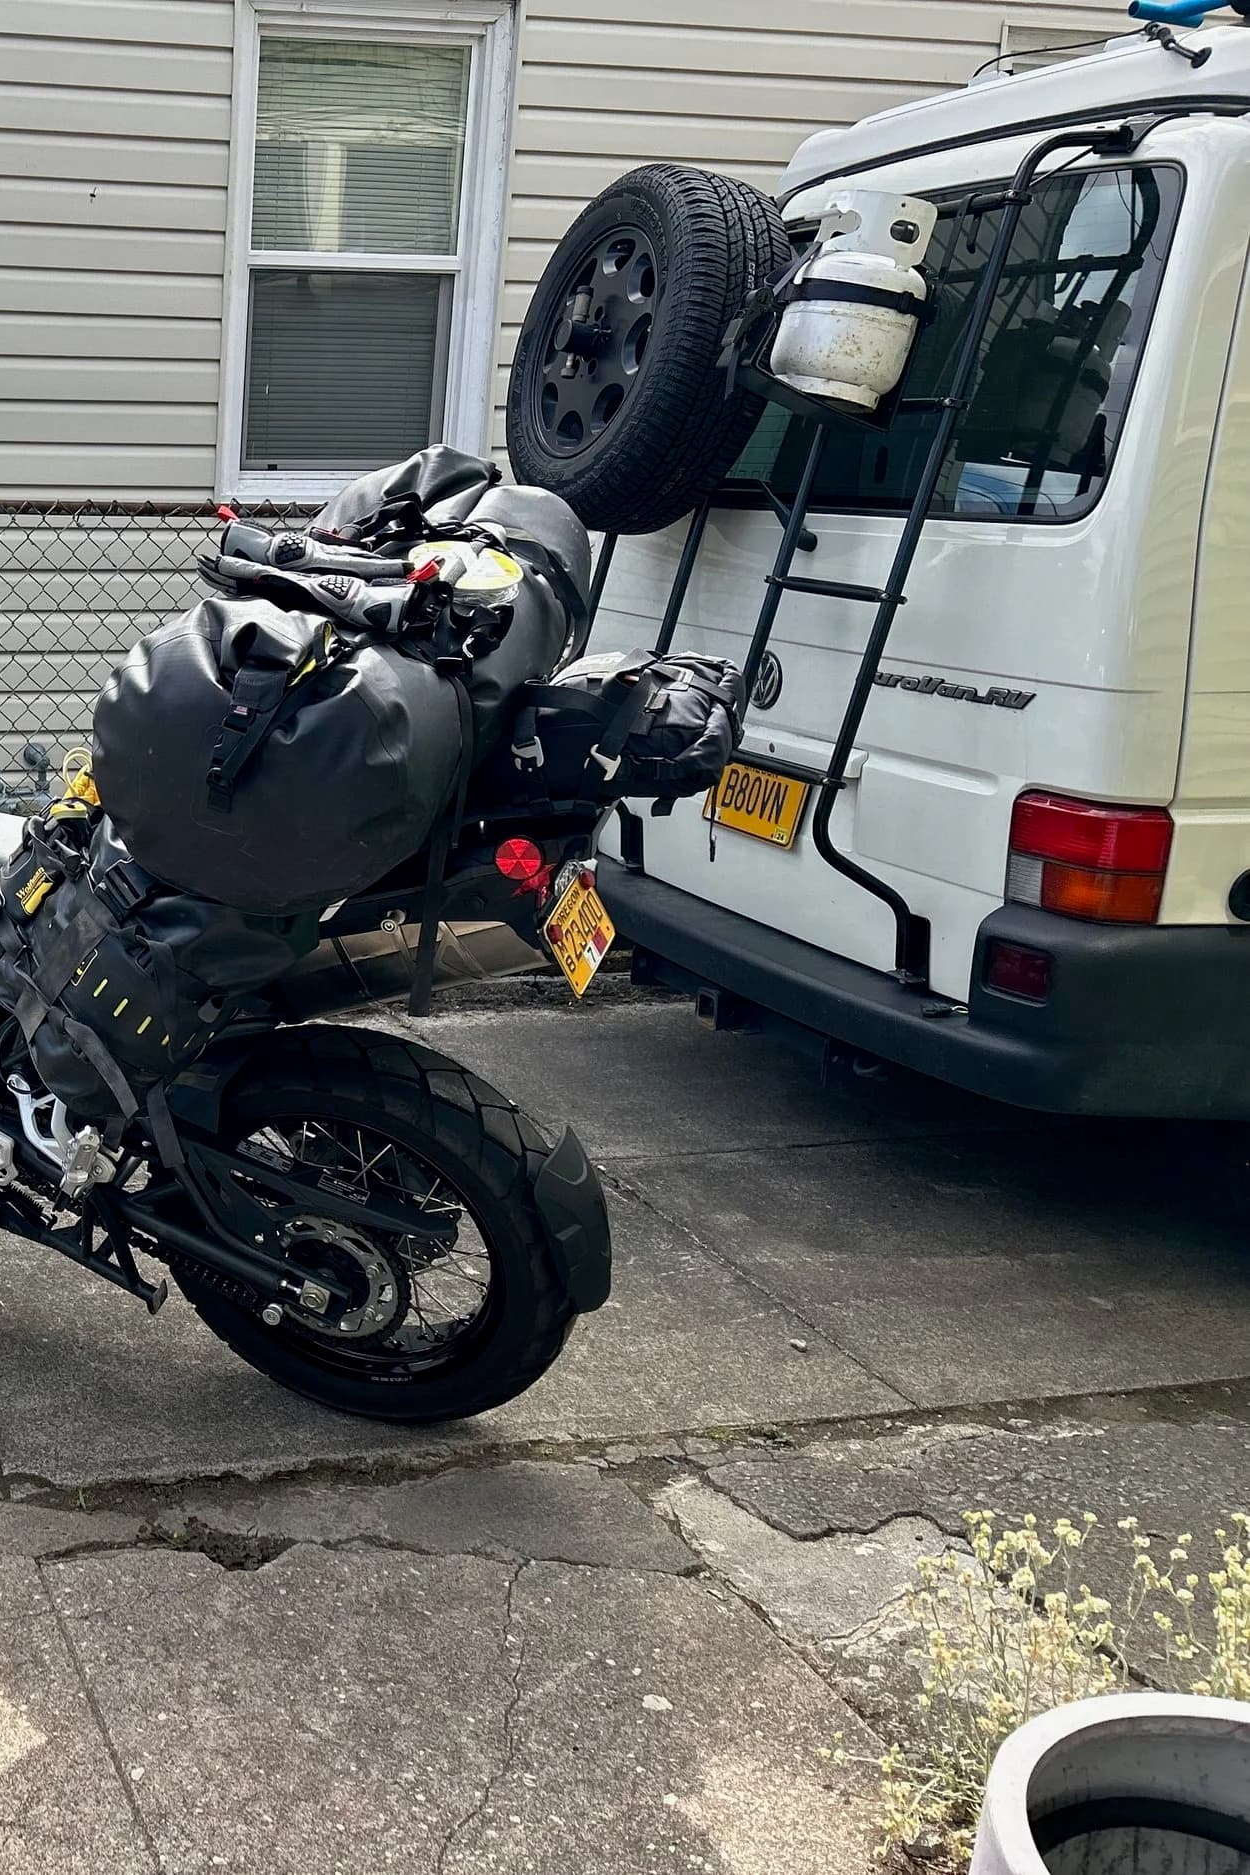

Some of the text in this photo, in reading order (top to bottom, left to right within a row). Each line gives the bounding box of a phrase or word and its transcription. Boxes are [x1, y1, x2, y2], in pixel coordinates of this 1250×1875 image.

[15, 866, 45, 900] Wolfman
[556, 887, 581, 926] OREGON
[564, 890, 603, 961] 23400
